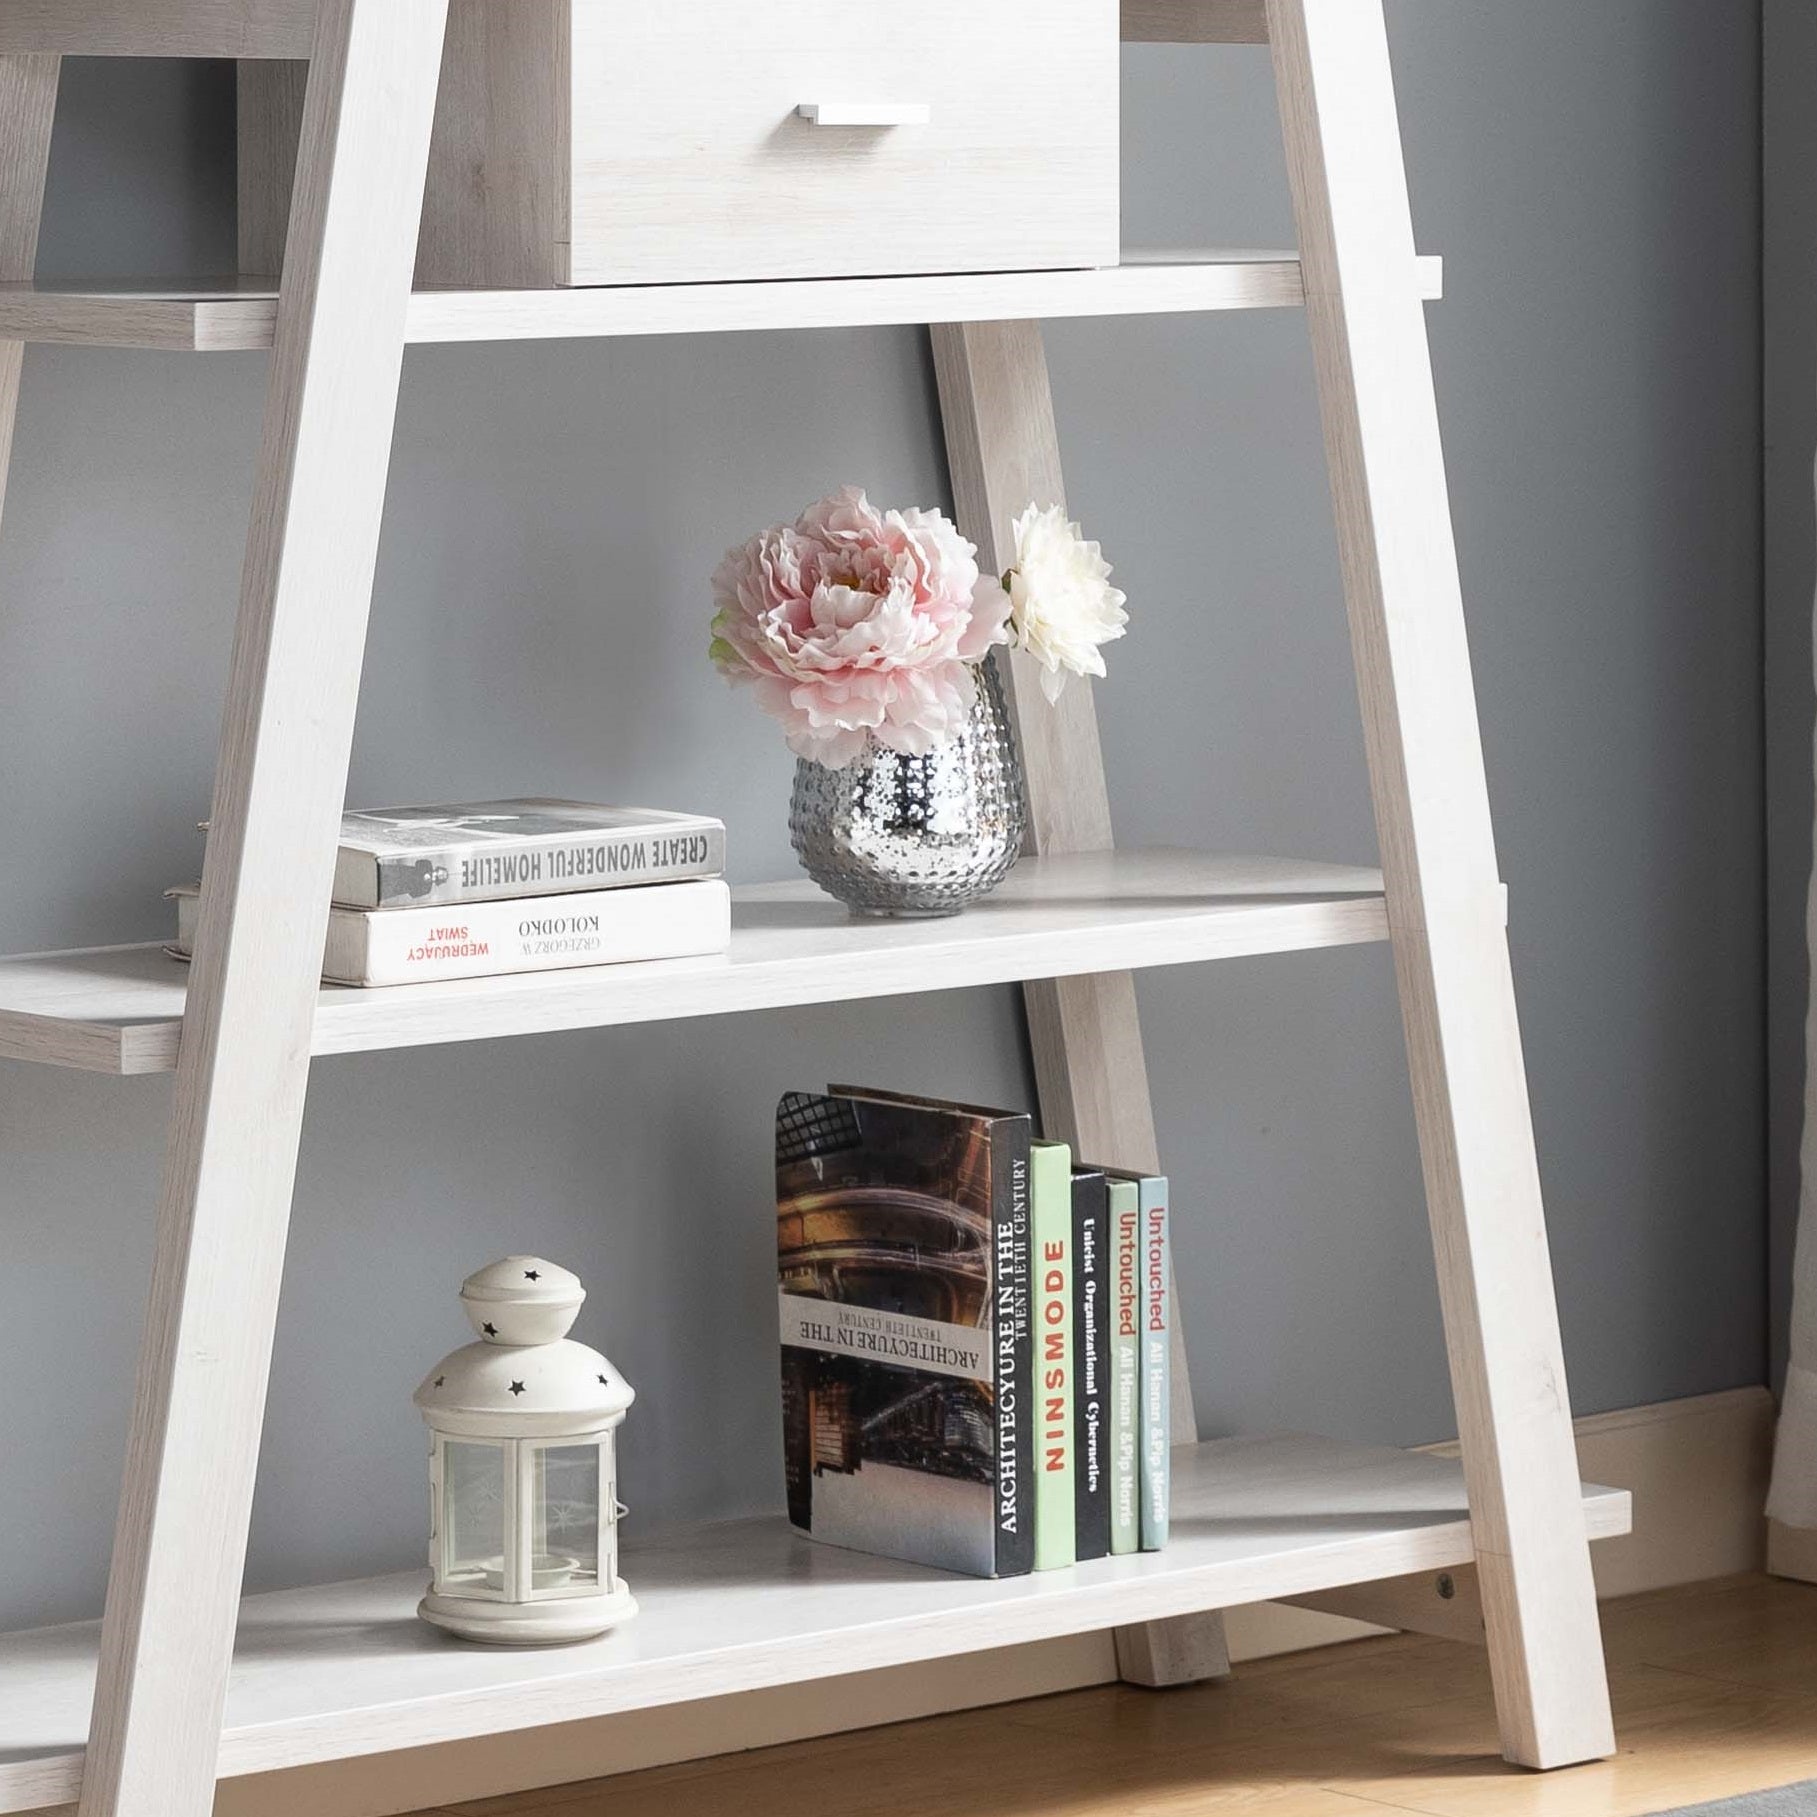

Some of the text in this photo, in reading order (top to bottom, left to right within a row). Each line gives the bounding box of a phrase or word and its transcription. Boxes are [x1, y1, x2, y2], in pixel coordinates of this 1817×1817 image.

[461, 835, 707, 887] CREATE WONDERFUL HOMELIFE
[535, 937, 600, 954] GRZEGORZ
[1012, 1159, 1028, 1340] TWENTIETH CENTURY
[1119, 1212, 1136, 1336] Untouched
[1149, 1207, 1165, 1332] Untouched
[799, 1321, 979, 1369] ARCHITECYURE IN THE
[838, 1312, 941, 1342] TWENTIETH CENTURY
[998, 1222, 1017, 1534] ARCHITECYURE IN THE
[1045, 1240, 1065, 1472] NINSMODE
[1083, 1218, 1100, 1493] Unicist Organizational Cybernetics
[1120, 1373, 1134, 1427] Hanan
[1150, 1368, 1163, 1422] Hanan
[1119, 1476, 1134, 1528] Norris
[1152, 1472, 1166, 1524] Norris
